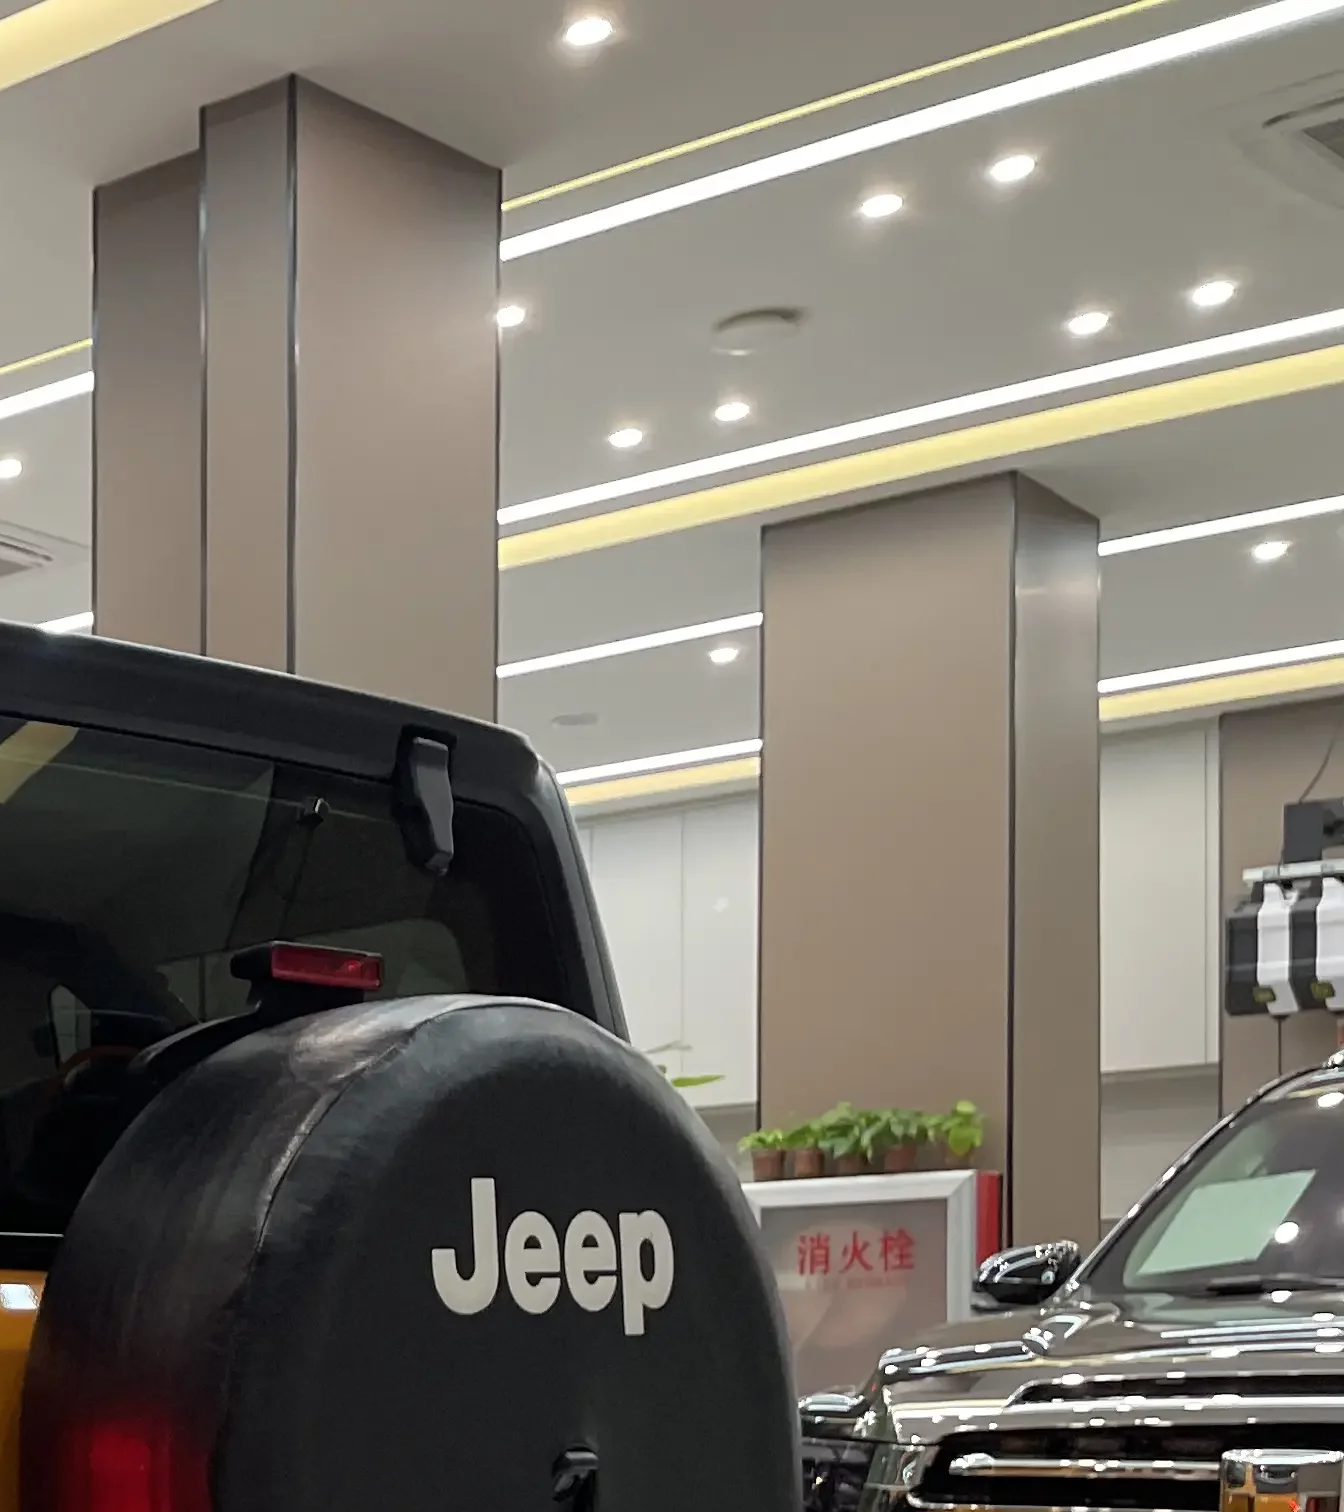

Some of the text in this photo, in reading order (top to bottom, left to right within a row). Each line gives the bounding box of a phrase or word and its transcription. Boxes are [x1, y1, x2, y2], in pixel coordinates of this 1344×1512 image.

[431, 1177, 674, 1336] Jeep
[797, 1228, 916, 1276] 消火栓
